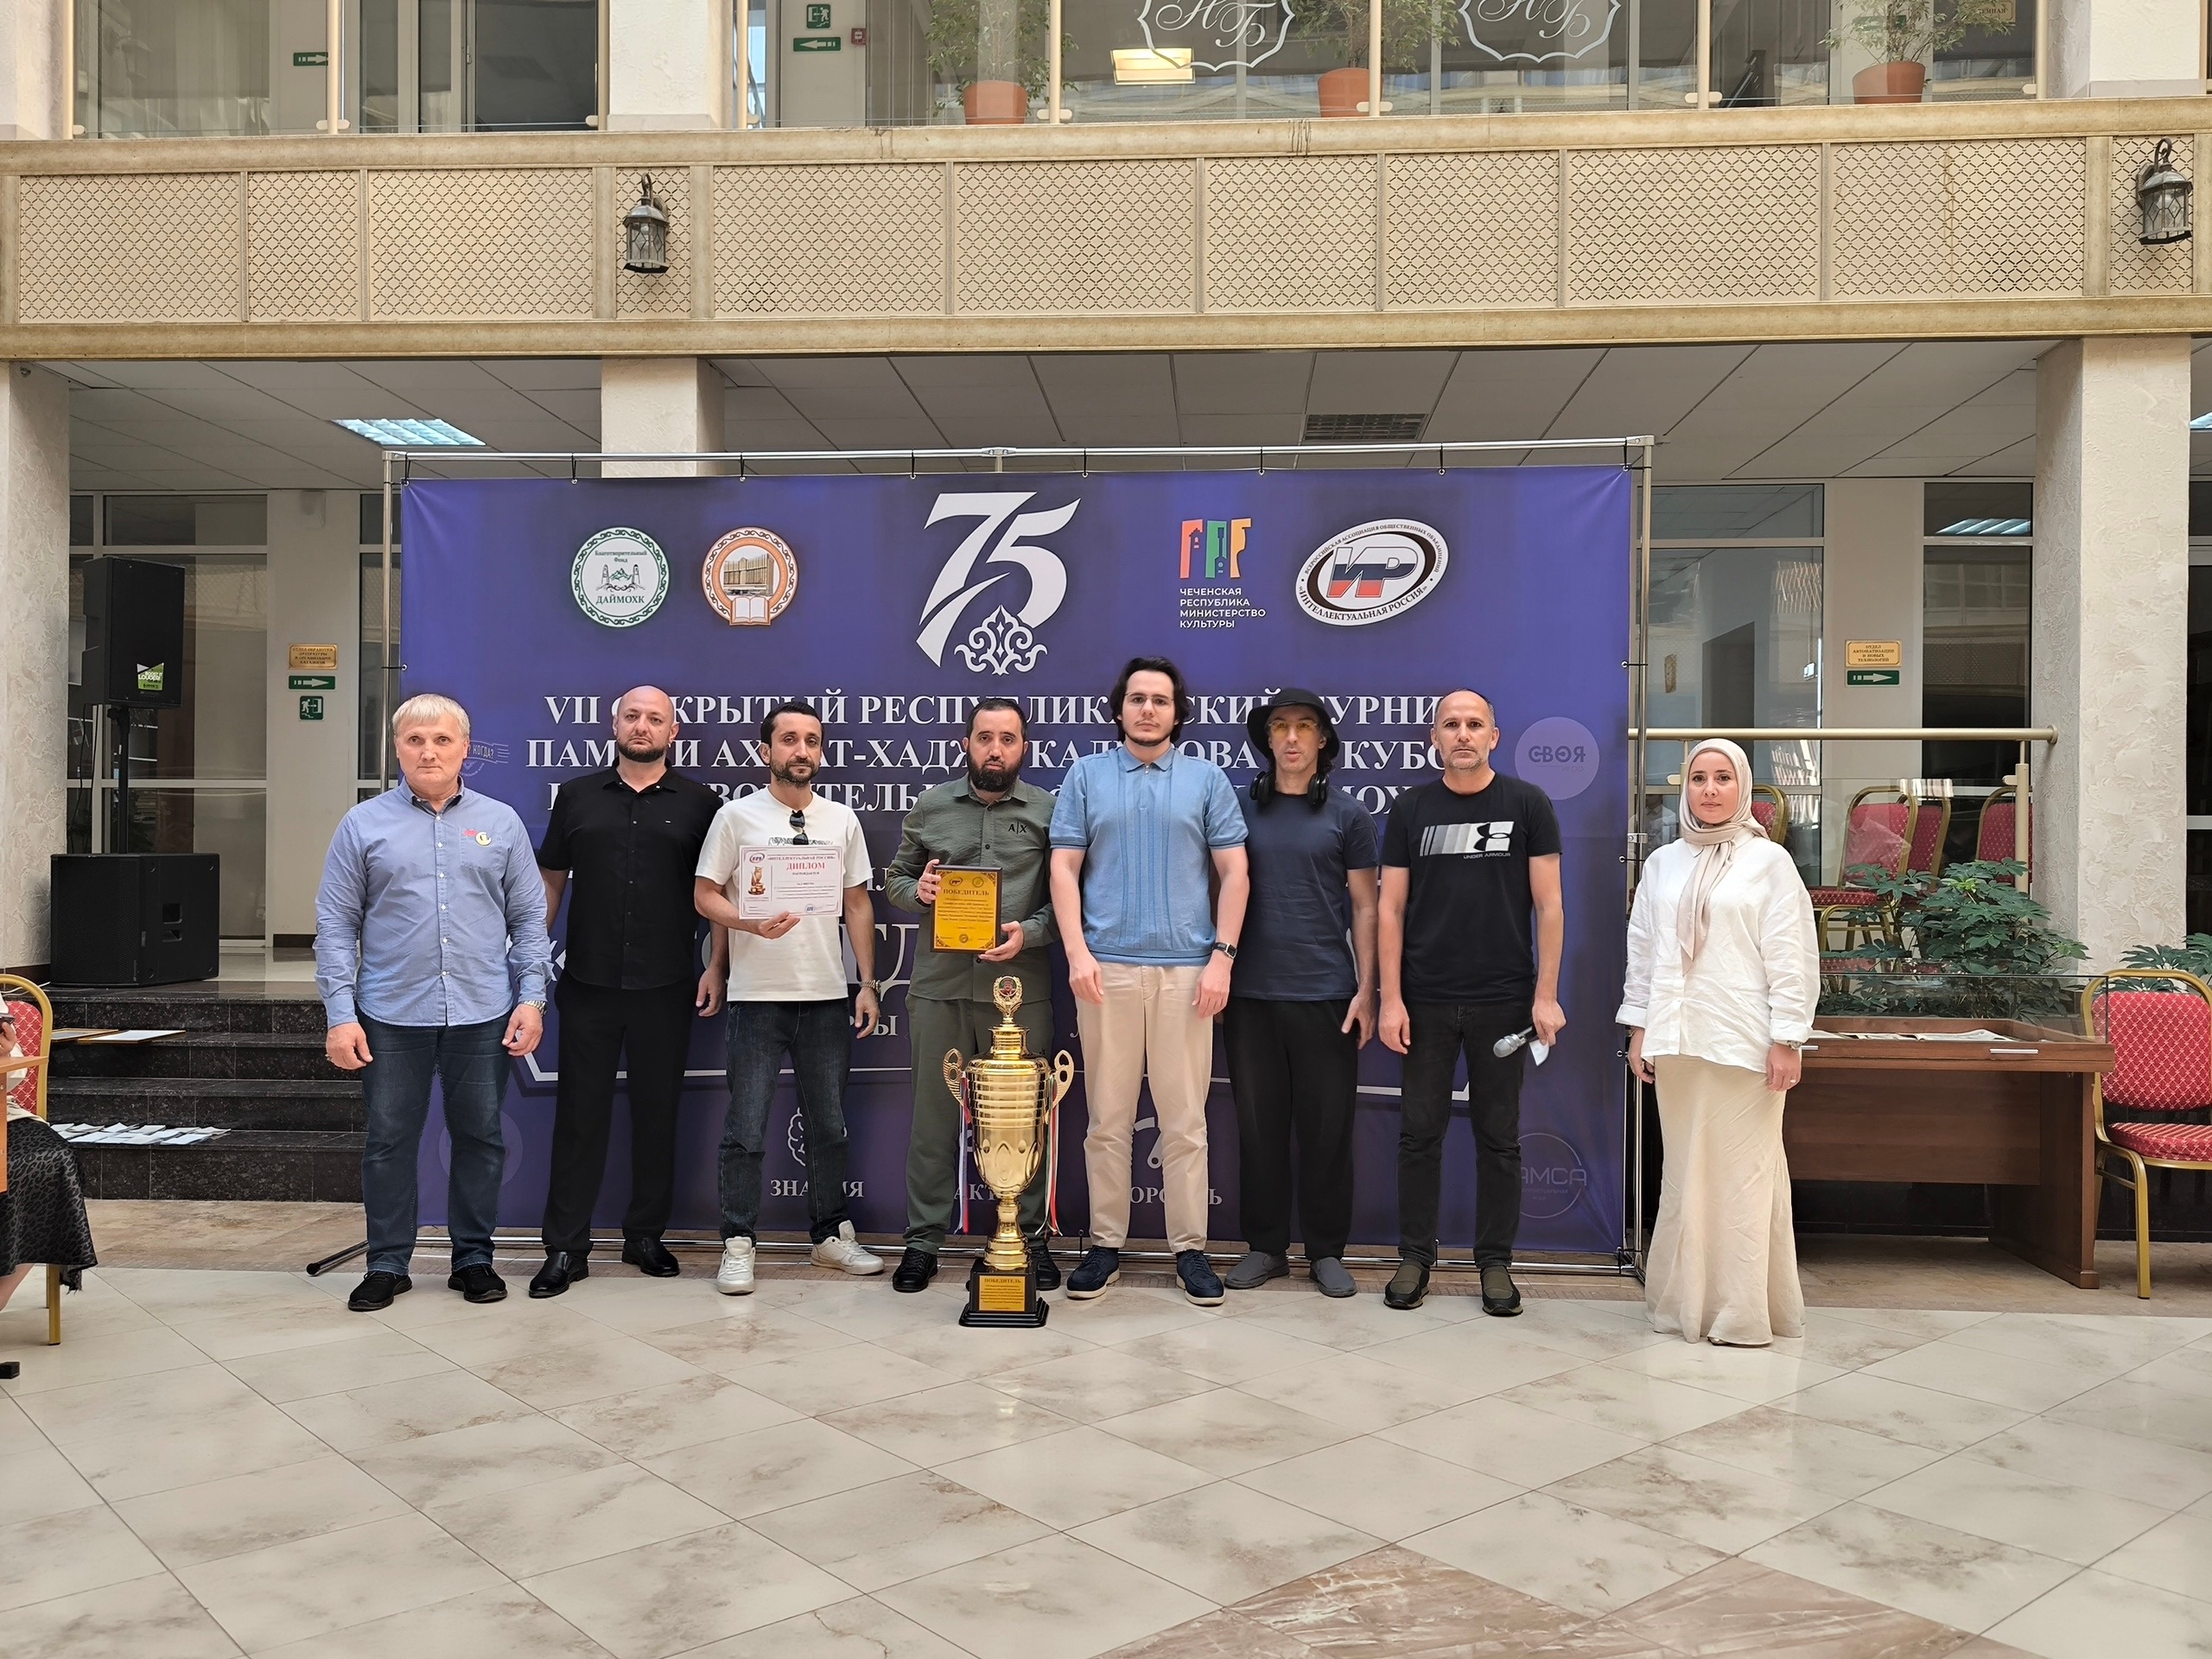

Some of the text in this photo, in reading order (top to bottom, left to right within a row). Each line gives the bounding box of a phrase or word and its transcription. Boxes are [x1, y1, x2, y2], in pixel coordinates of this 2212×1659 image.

[1305, 524, 1444, 575] ВСЕРОССИЙСКАЯ АССОЦИАЦИЯ ОБЩЕСТВЕННЫХ ОБЪЕДИНЕНИЙ
[916, 492, 1082, 668] 75
[1326, 546, 1419, 599] ИР
[595, 594, 645, 605] ДАЙМОХК
[1179, 588, 1242, 596] ЧЕЧЕНСКАЯ
[1298, 586, 1427, 620] «ИНТЕЛЛЕКТУАЛЬНАЯ РОССИЯ»
[1179, 609, 1267, 618] МИНИСТЕРСТВО
[1179, 620, 1236, 628] КУЛЬТУРЫ
[544, 696, 601, 724] VII
[612, 688, 849, 724] КРЫТЙ
[1319, 696, 1444, 725] УРНИ
[526, 740, 1446, 776] ПАМИ АХТ-ХАД КАОВА КУБО
[1528, 746, 1586, 763] СВОЯ
[1521, 1167, 1587, 1186] АМСА
[770, 1179, 865, 1198] ЗНАЯ
